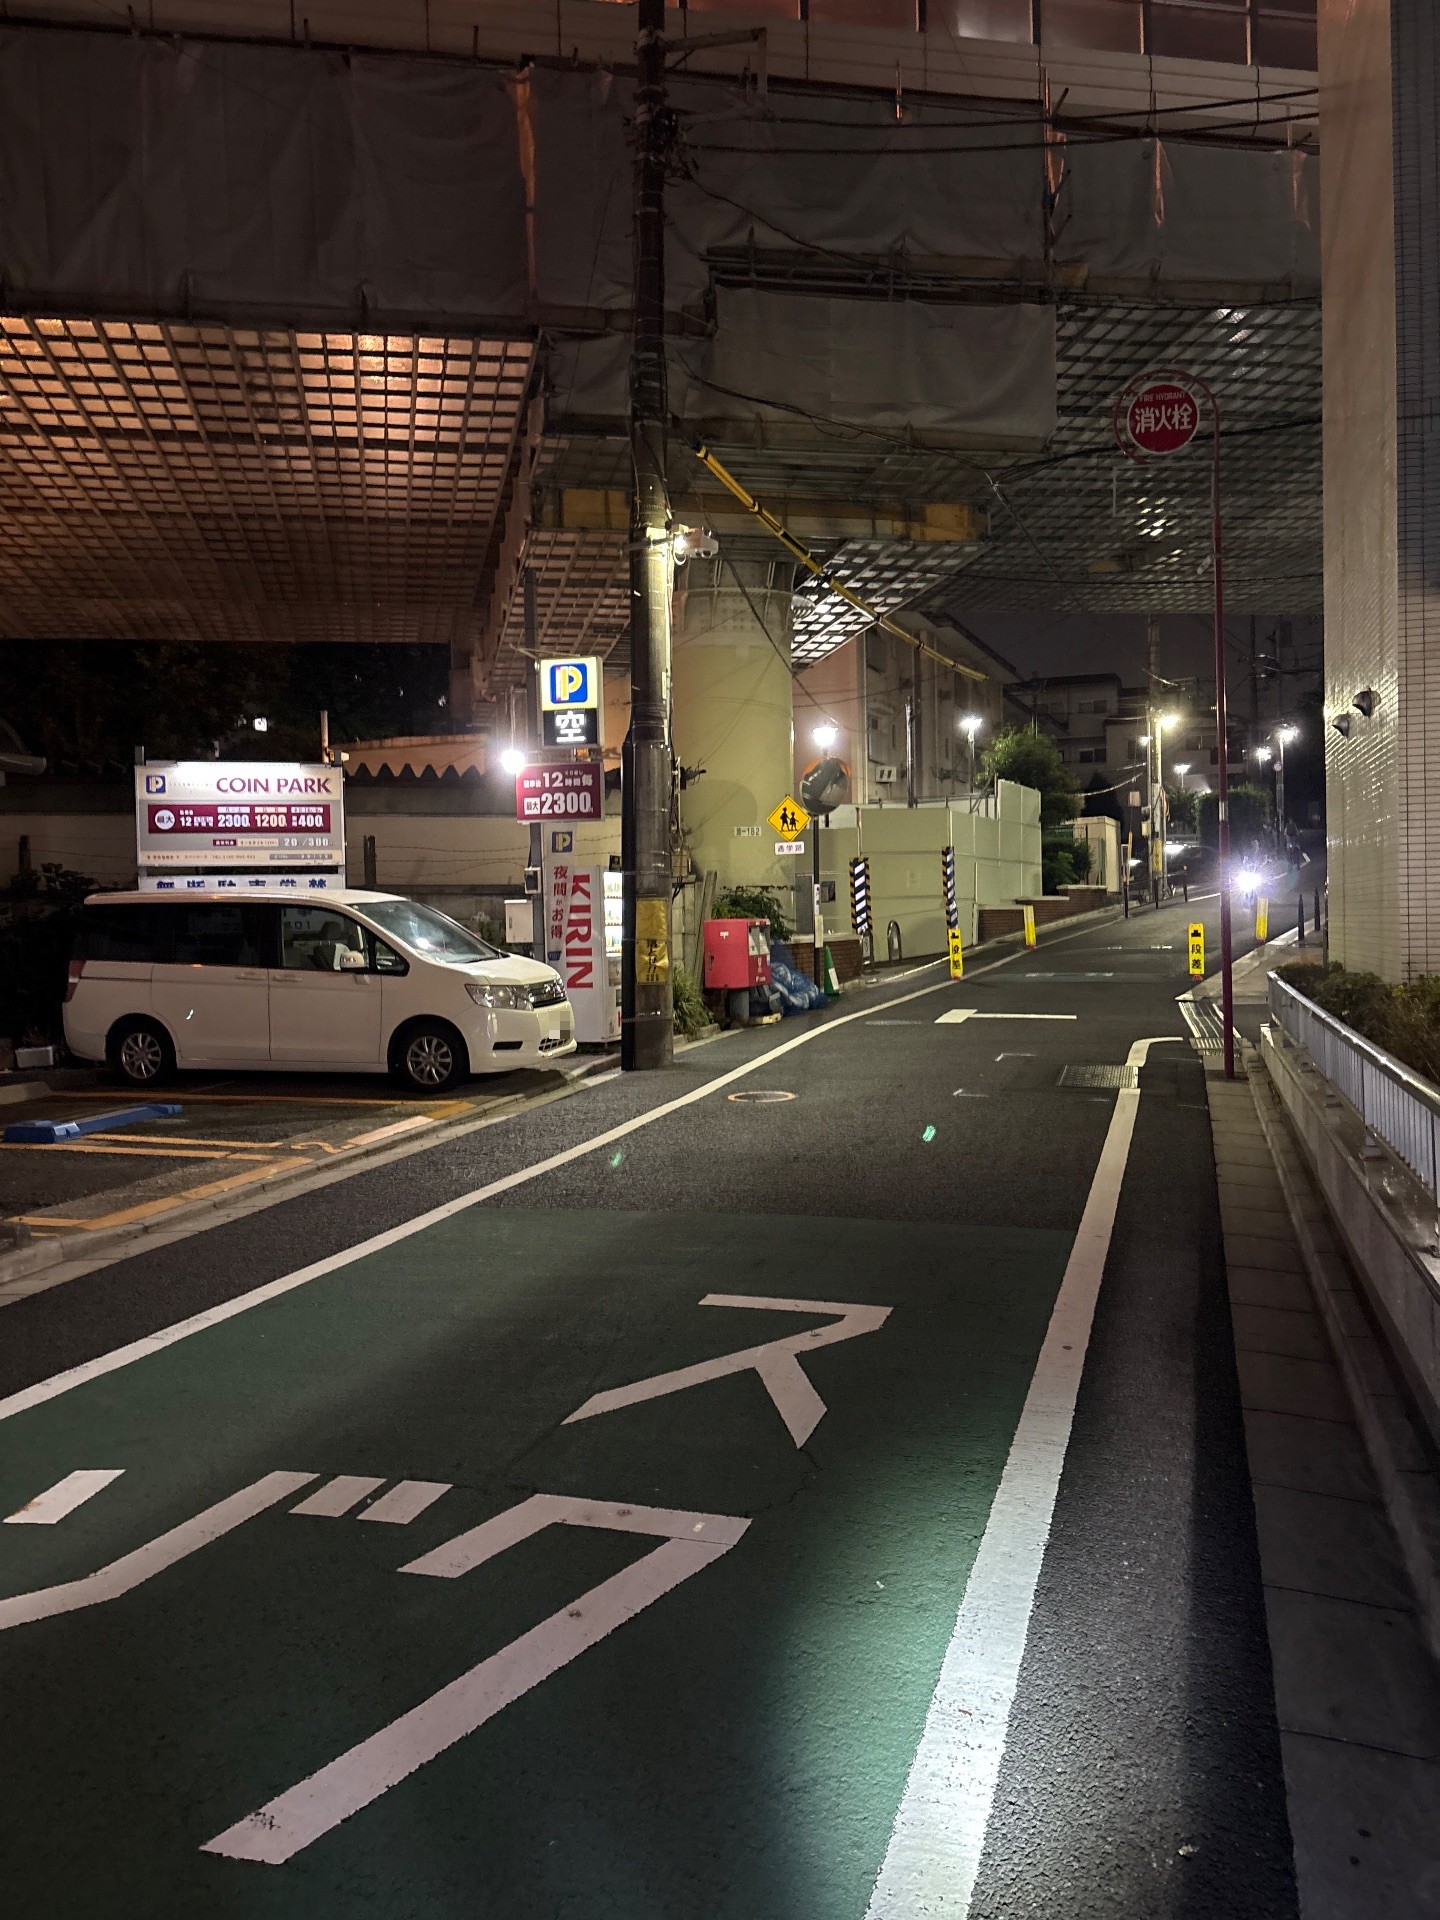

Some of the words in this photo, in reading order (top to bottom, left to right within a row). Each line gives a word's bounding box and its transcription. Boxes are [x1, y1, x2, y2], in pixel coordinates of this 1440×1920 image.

[1135, 403, 1193, 434] 消火栓
[555, 710, 586, 743] 空
[216, 777, 270, 793] COIN
[277, 777, 332, 793] PARK
[550, 865, 568, 939] 夜間がお得
[565, 874, 594, 989] KIRIN
